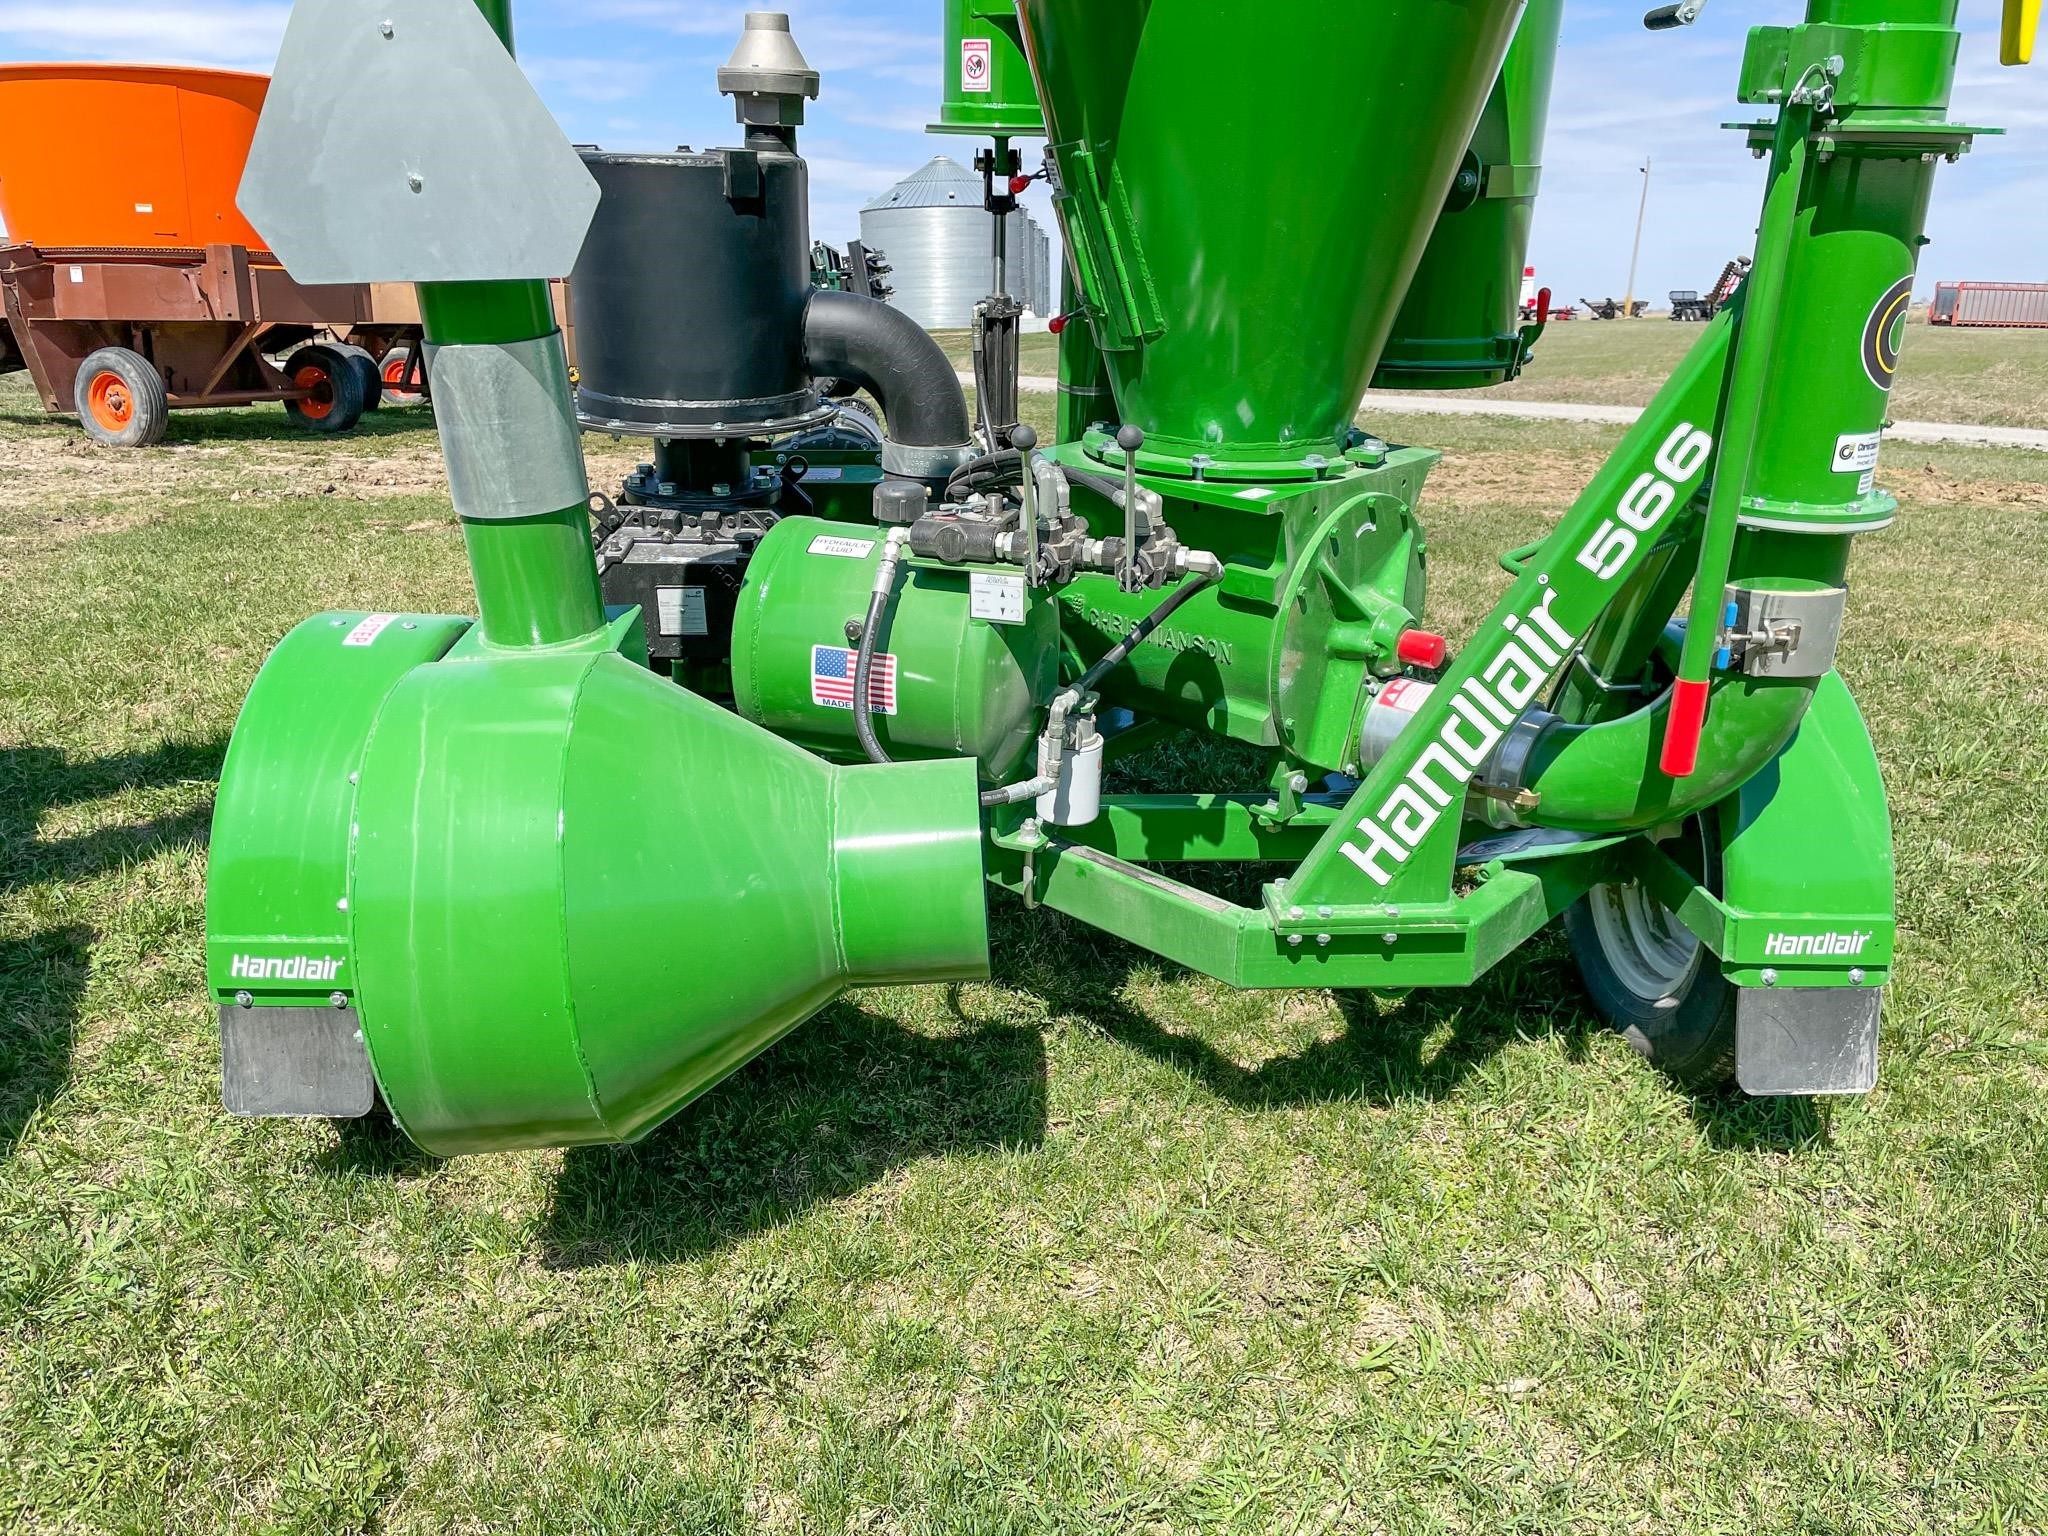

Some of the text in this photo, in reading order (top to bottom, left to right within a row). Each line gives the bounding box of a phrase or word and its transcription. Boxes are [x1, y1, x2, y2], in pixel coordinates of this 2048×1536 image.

[1575, 421, 1713, 580] 566
[815, 538, 872, 549] HYDRAULIC
[824, 546, 853, 554] FLUID
[822, 698, 852, 709] MADE
[1764, 930, 1872, 955] Handlair
[231, 954, 344, 980] Handlair
